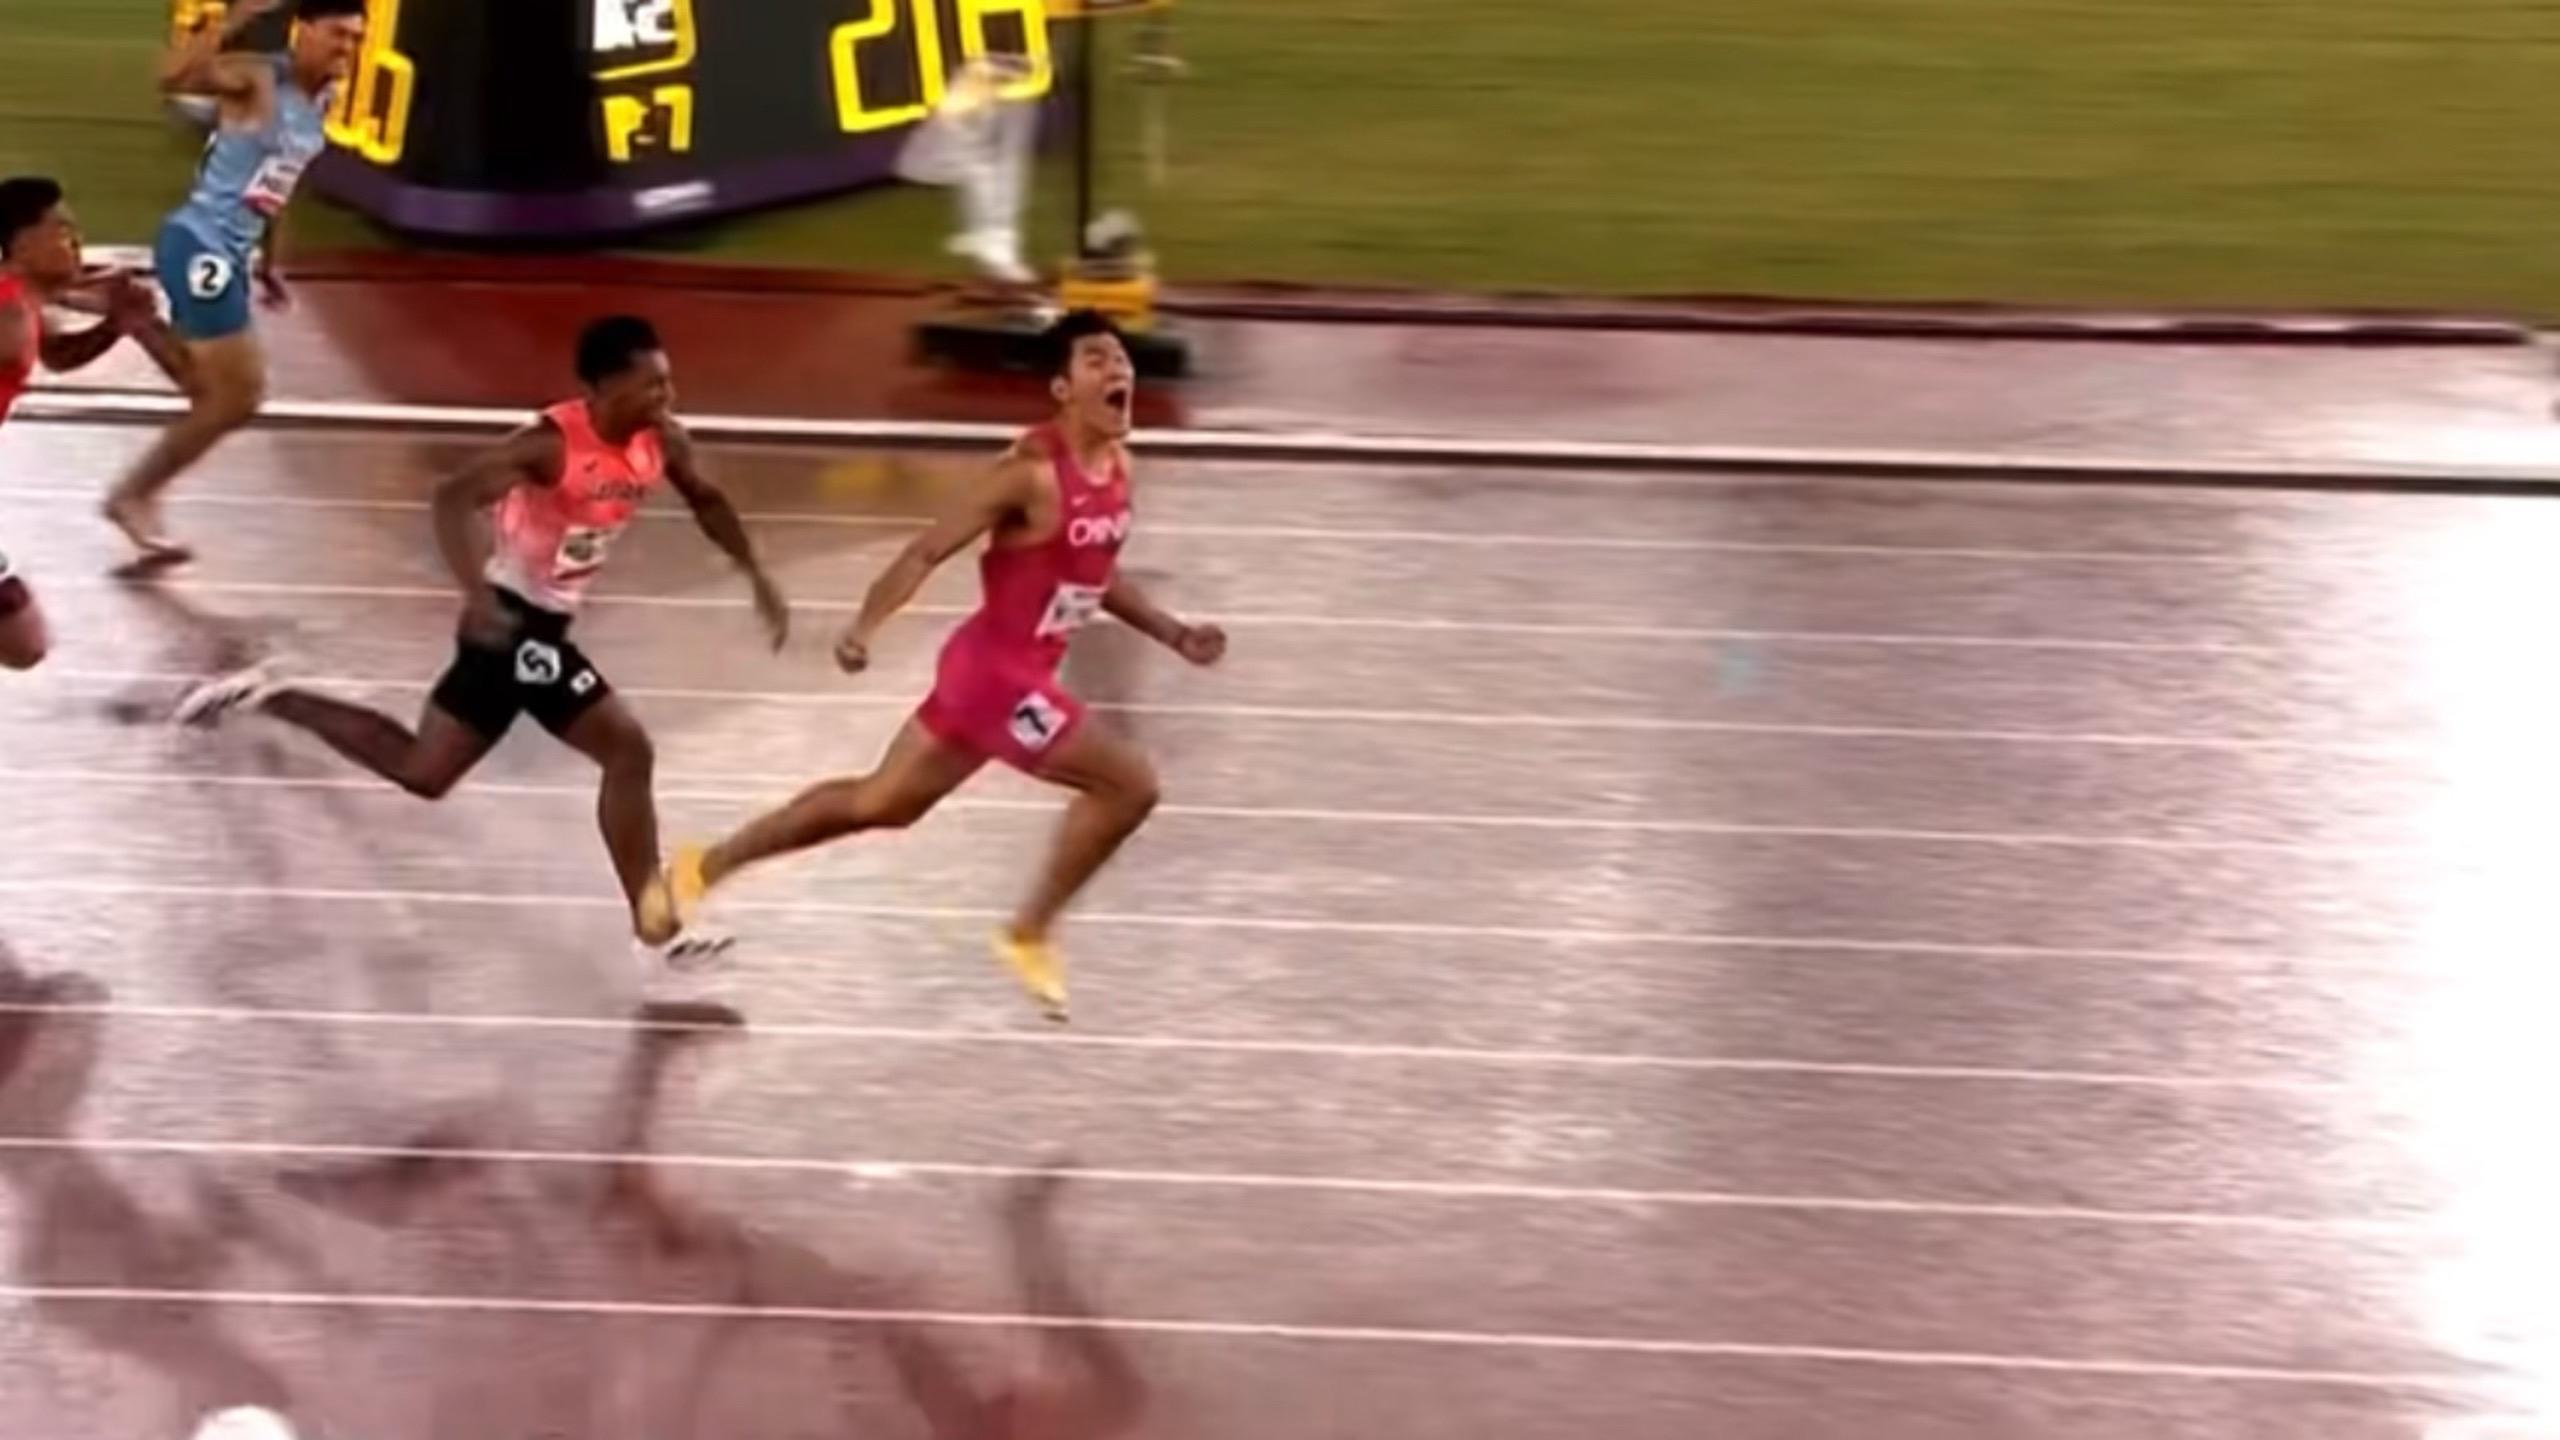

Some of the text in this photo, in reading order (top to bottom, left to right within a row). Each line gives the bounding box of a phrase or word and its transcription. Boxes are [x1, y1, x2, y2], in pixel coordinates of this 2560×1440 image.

[200, 260, 219, 291] 2
[523, 648, 554, 679] 5
[1015, 705, 1049, 737] 7
